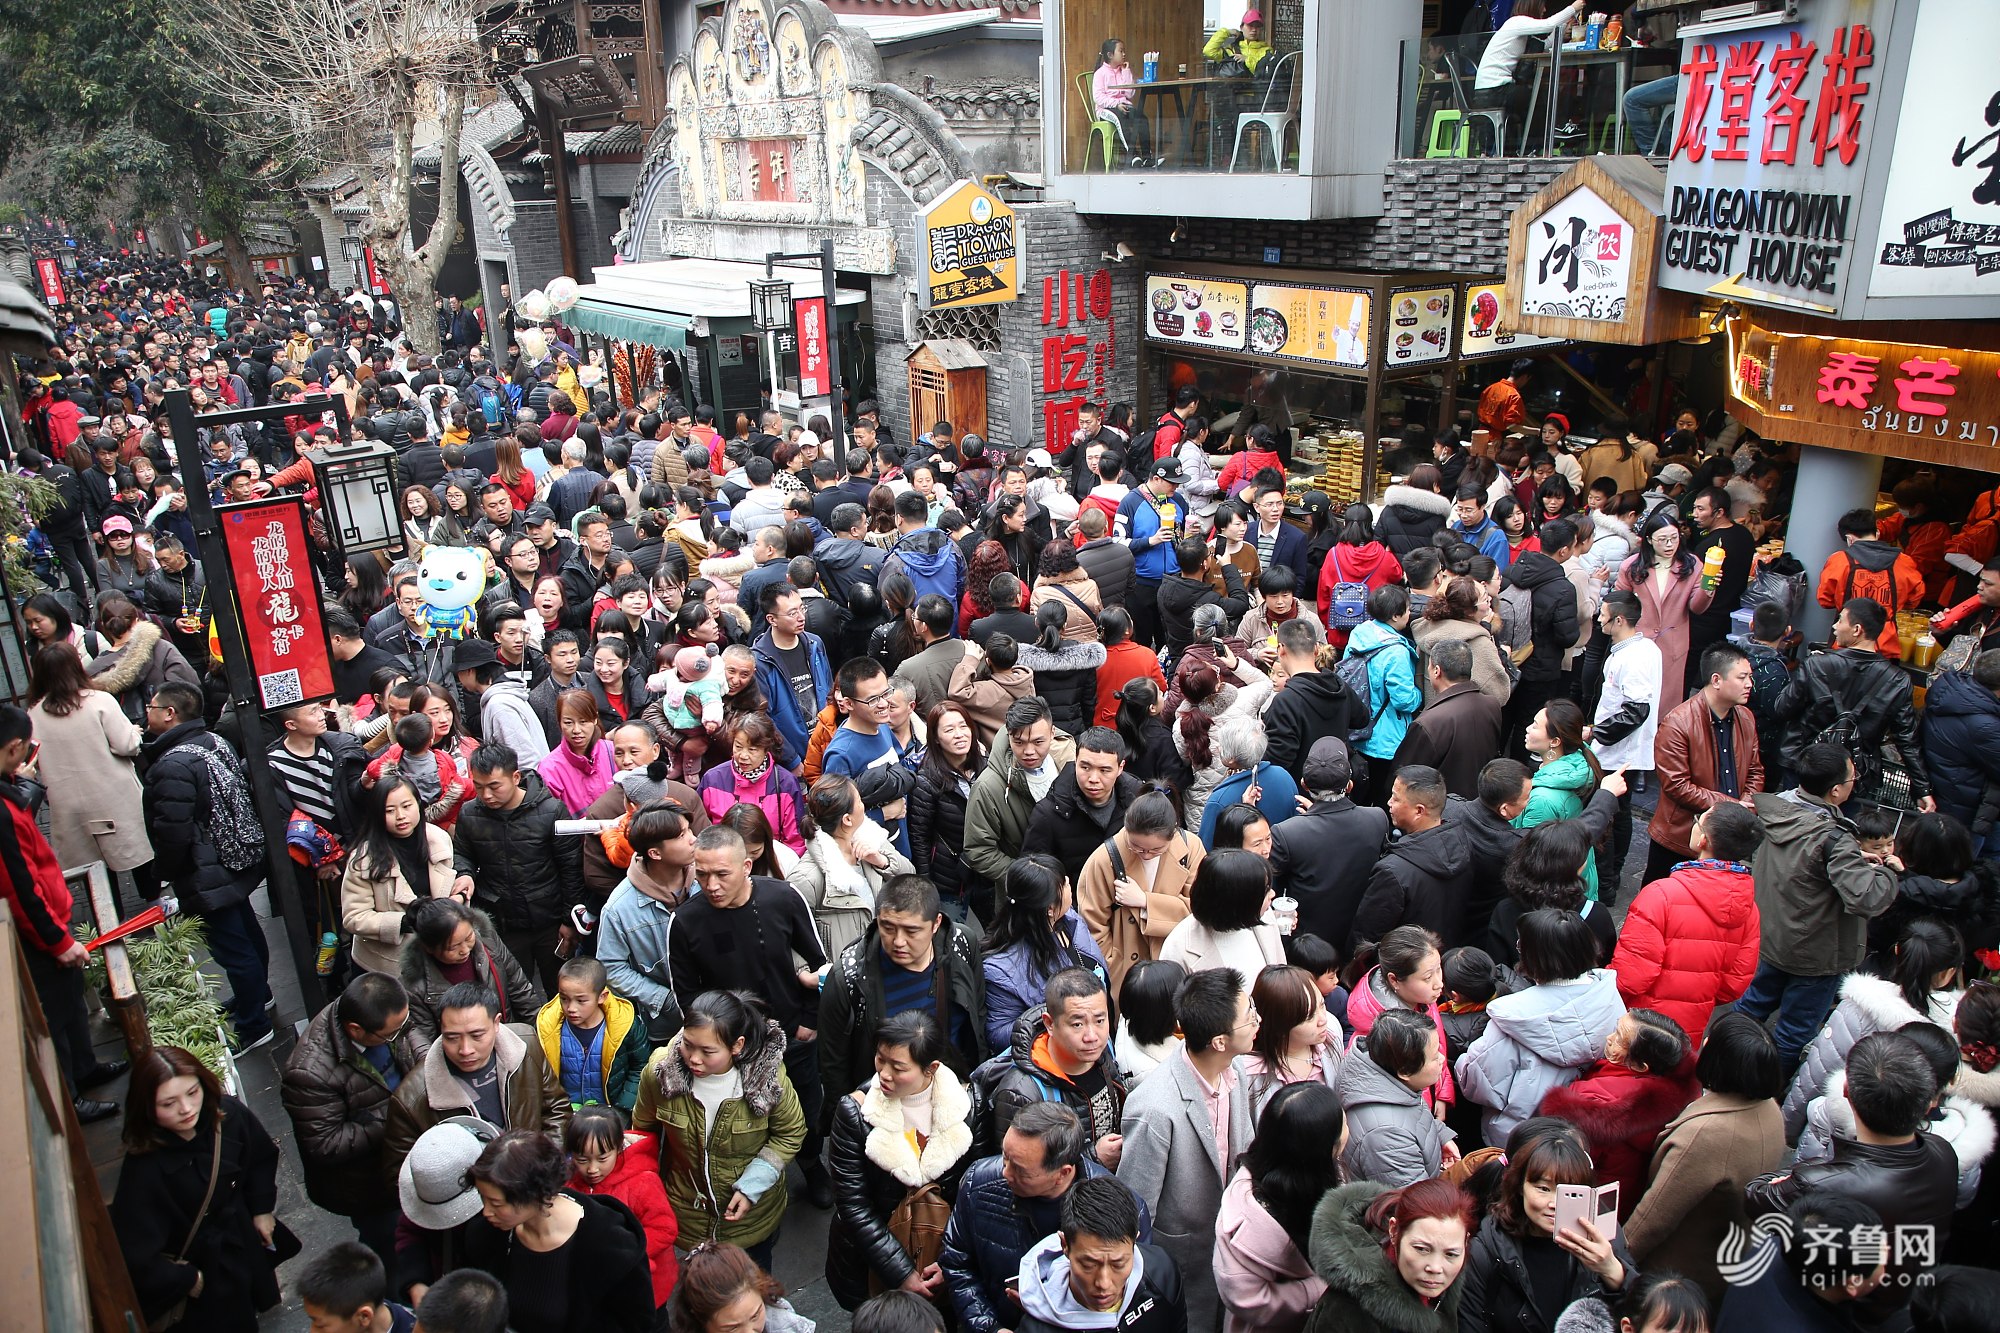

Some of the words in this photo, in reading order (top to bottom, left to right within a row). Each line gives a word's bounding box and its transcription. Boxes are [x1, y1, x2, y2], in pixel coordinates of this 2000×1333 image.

[1669, 24, 1874, 167] 龙堂客栈
[957, 215, 1012, 238] DRAGON
[1670, 185, 1851, 243] DRAGONTOWN
[1949, 221, 2000, 244] 傳統名
[959, 231, 1013, 257] TOWN
[961, 254, 988, 267] GUEST
[988, 248, 1016, 262] HOUSE
[1665, 229, 1740, 276] GUEST
[1746, 237, 1843, 295] HOUSE
[1885, 245, 1917, 266] 客棧
[1583, 280, 1618, 292] Iced-Drinks
[1041, 269, 1089, 456] 小吃城
[1094, 342, 1108, 398] Snack
[251, 536, 279, 593] 龙的传人
[266, 521, 295, 590] 龙的传人用
